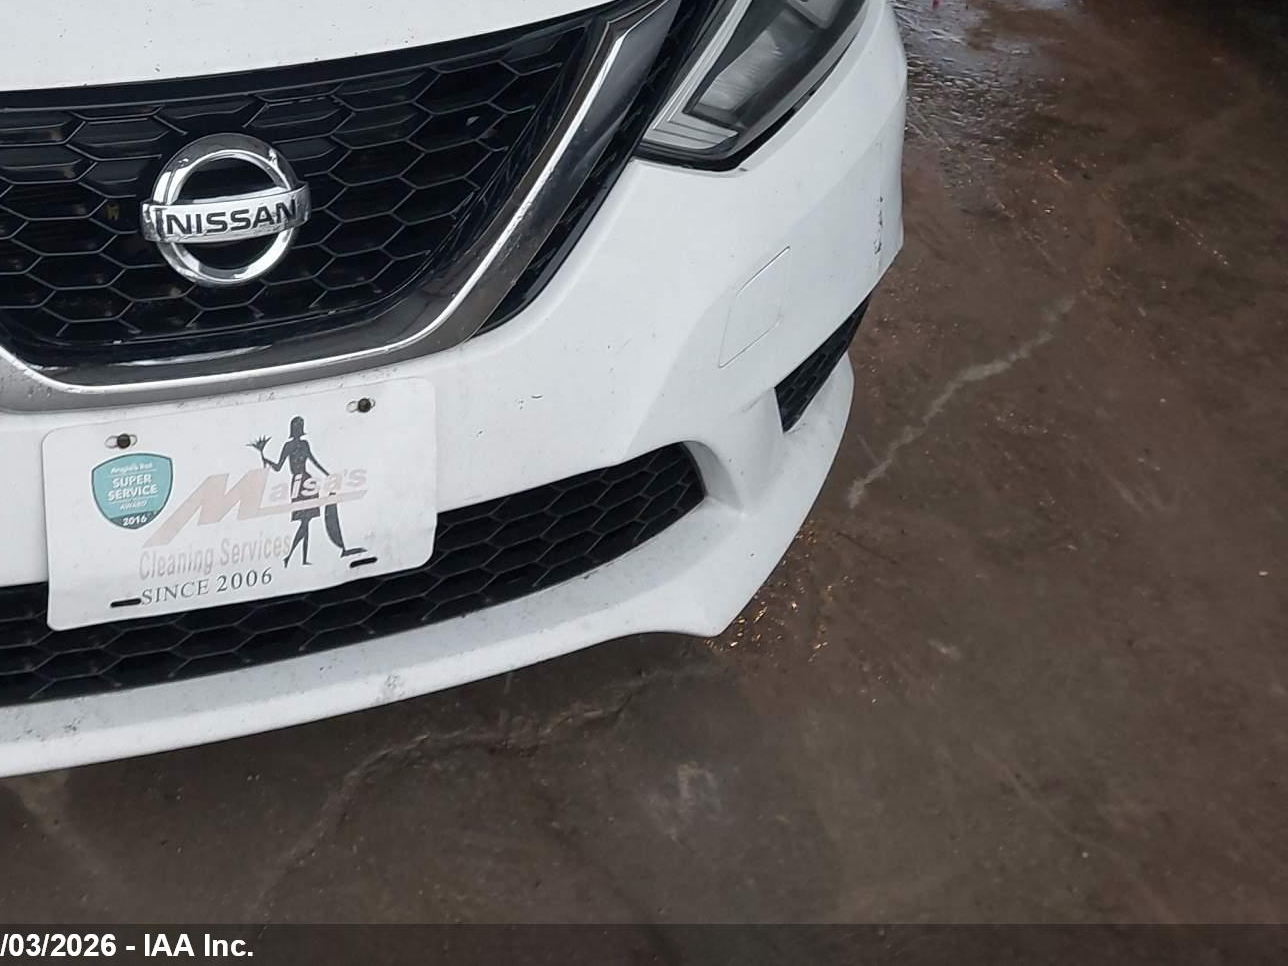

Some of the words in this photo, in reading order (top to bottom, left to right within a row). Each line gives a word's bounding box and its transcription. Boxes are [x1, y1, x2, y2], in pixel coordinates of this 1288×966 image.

[165, 199, 298, 235] NISSAN
[107, 483, 159, 502] SERVICE
[112, 473, 152, 489] SUPER
[122, 513, 148, 527] 2016
[139, 543, 213, 581] Cleaning
[220, 531, 291, 566] Services
[140, 578, 210, 606] SINCE
[216, 567, 273, 593] 2006
